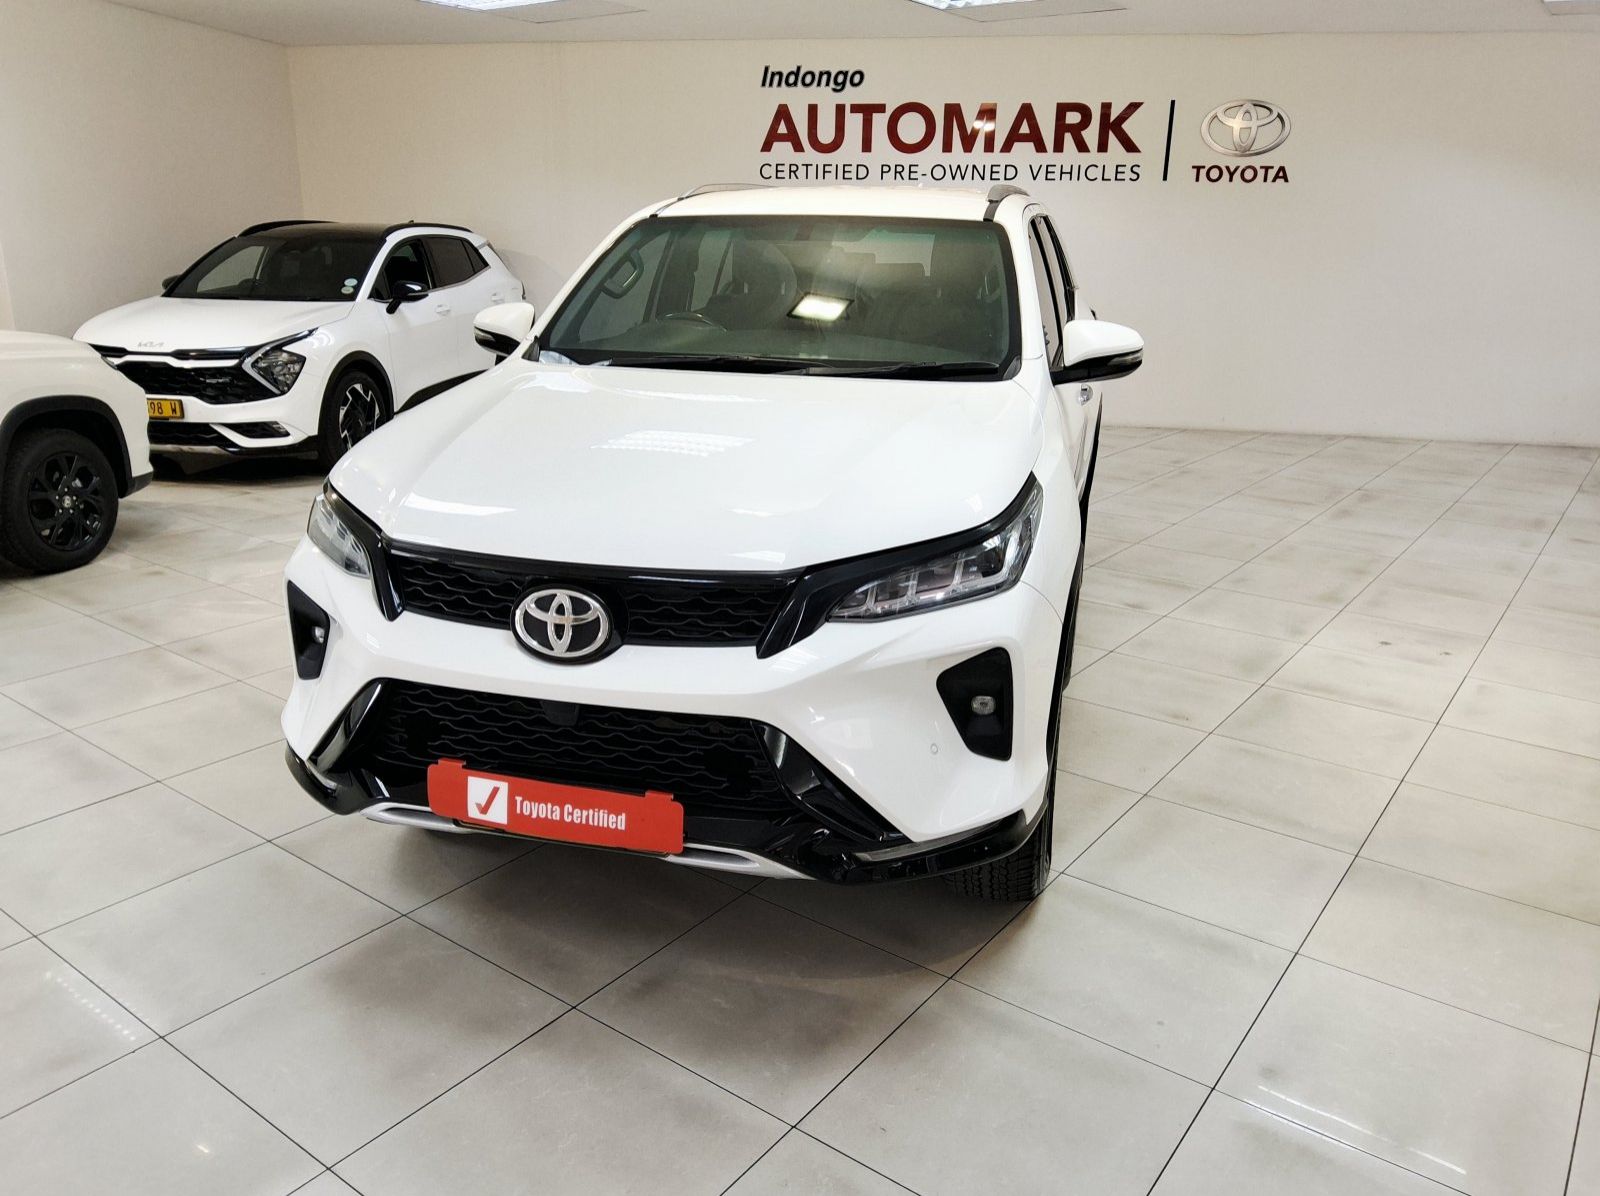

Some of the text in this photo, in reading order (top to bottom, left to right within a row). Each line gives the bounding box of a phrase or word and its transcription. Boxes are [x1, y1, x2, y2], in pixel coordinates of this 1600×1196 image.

[761, 65, 864, 93] Indongo
[760, 101, 1144, 153] AUTOMARK
[759, 163, 1141, 182] CERTIFIED PRE-OWNED VEHICLES
[1191, 165, 1290, 183] TOYOTA
[515, 796, 626, 830] Toyota Certified
